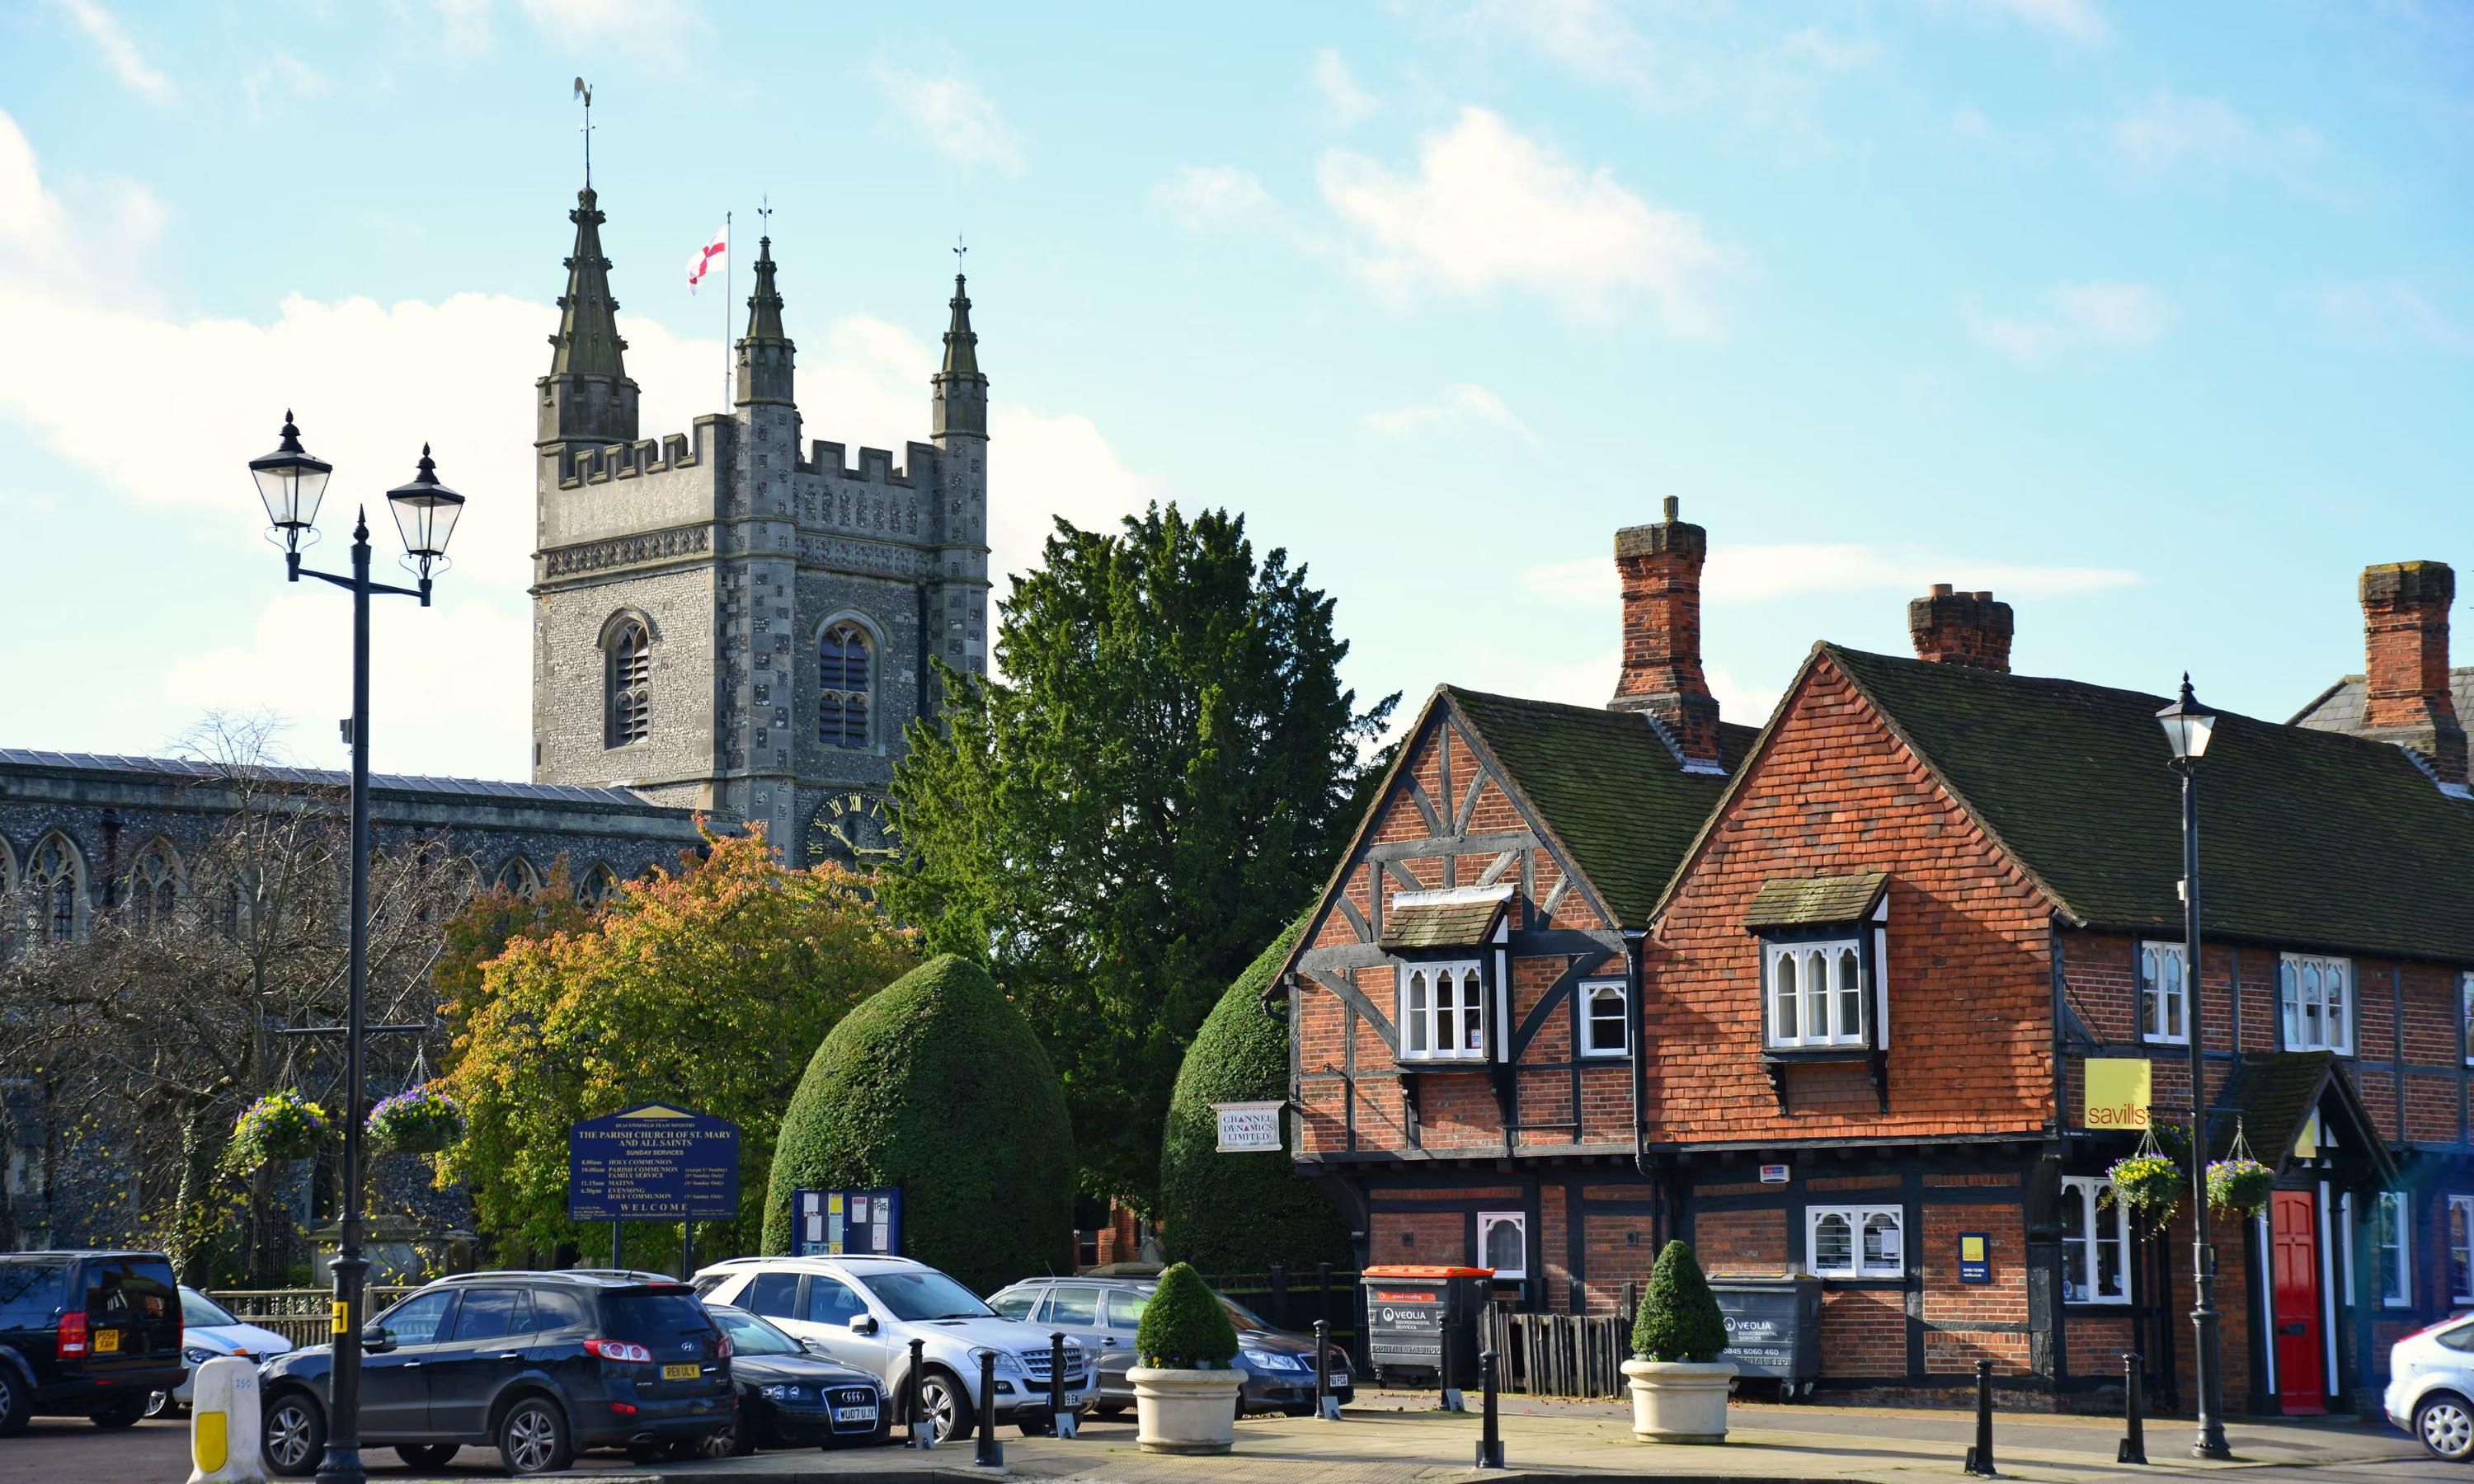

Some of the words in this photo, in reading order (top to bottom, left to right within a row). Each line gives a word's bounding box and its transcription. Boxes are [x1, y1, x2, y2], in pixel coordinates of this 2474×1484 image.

[2088, 1103, 2147, 1125] savills
[1223, 1115, 1272, 1123] CHANNEL
[1224, 1124, 1274, 1132] DYNAMICS
[1229, 1133, 1270, 1141] LIMITED
[620, 1204, 688, 1212] WELCOME
[1395, 1311, 1427, 1320] VEOLIA
[1737, 1322, 1771, 1330] VEOLIA
[840, 1409, 859, 1420] WU07
